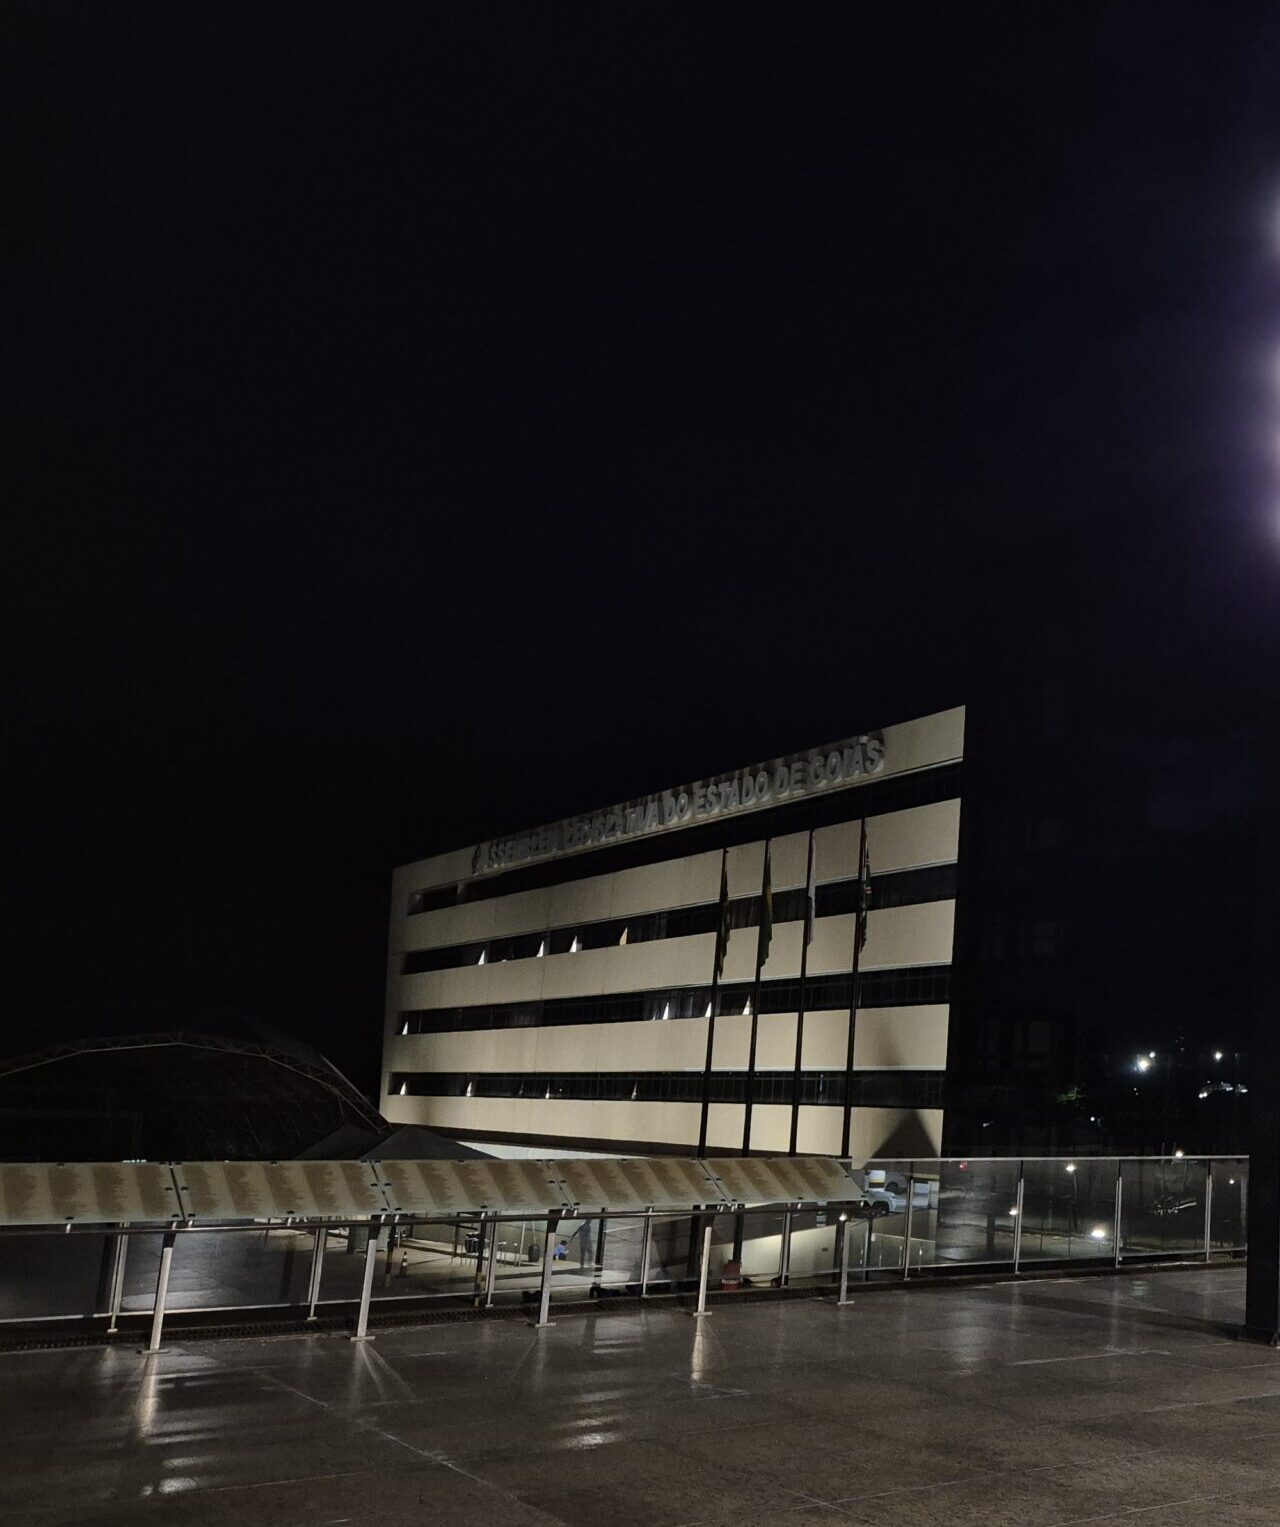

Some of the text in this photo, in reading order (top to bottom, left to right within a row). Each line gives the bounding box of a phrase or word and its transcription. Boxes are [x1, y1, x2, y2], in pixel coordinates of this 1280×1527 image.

[664, 788, 690, 821] DO
[692, 770, 770, 815] ESTADO
[774, 761, 809, 797] DE
